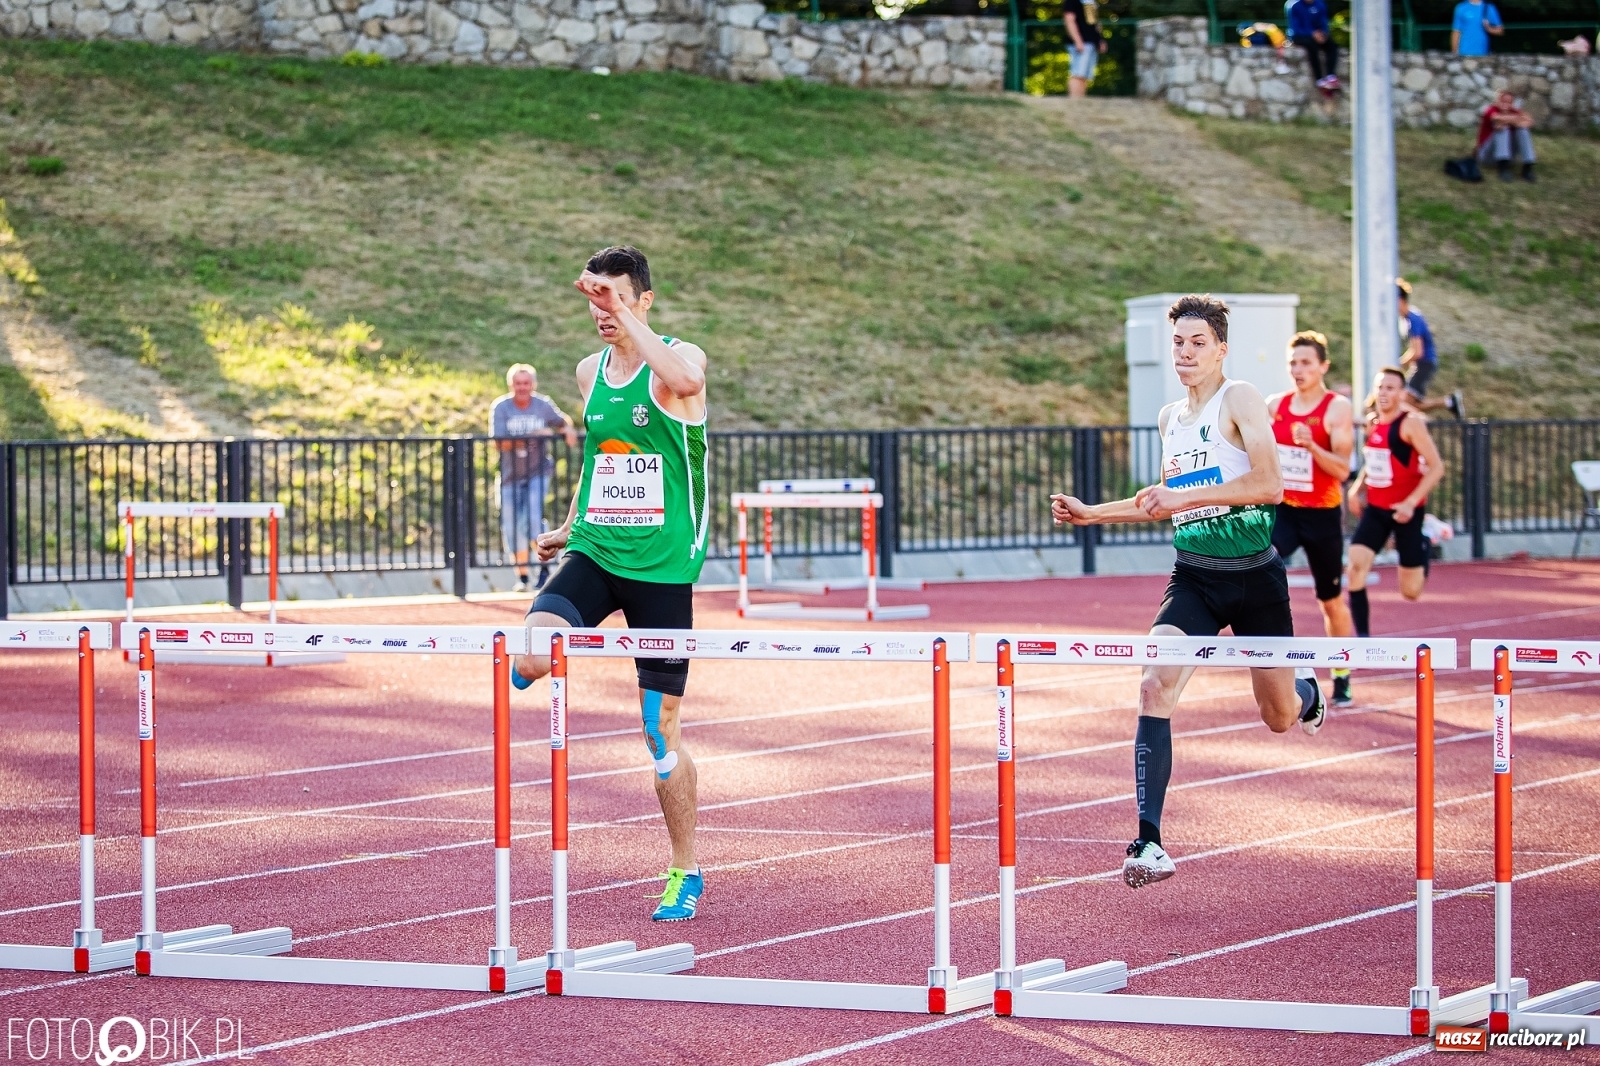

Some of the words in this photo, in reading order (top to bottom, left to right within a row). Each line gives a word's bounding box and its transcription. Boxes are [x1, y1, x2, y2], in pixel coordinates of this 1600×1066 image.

[626, 457, 659, 474] 104
[602, 485, 646, 499] HOŁUB
[1203, 506, 1220, 517] 2019
[593, 514, 632, 524] RACIBÓRZ
[634, 516, 653, 524] 2019
[222, 634, 252, 643] ORLEN
[305, 634, 324, 646] 4F
[640, 639, 673, 649] ORLEN
[730, 641, 751, 653] 4F
[813, 646, 841, 654] 4MOVE
[1096, 646, 1132, 656] ORLEN
[1194, 647, 1217, 659] 4F
[1286, 652, 1316, 660] 4MOVE
[140, 689, 149, 727] polanik
[552, 696, 561, 736] polanik
[998, 705, 1008, 747] polanik
[1496, 715, 1506, 759] polanik
